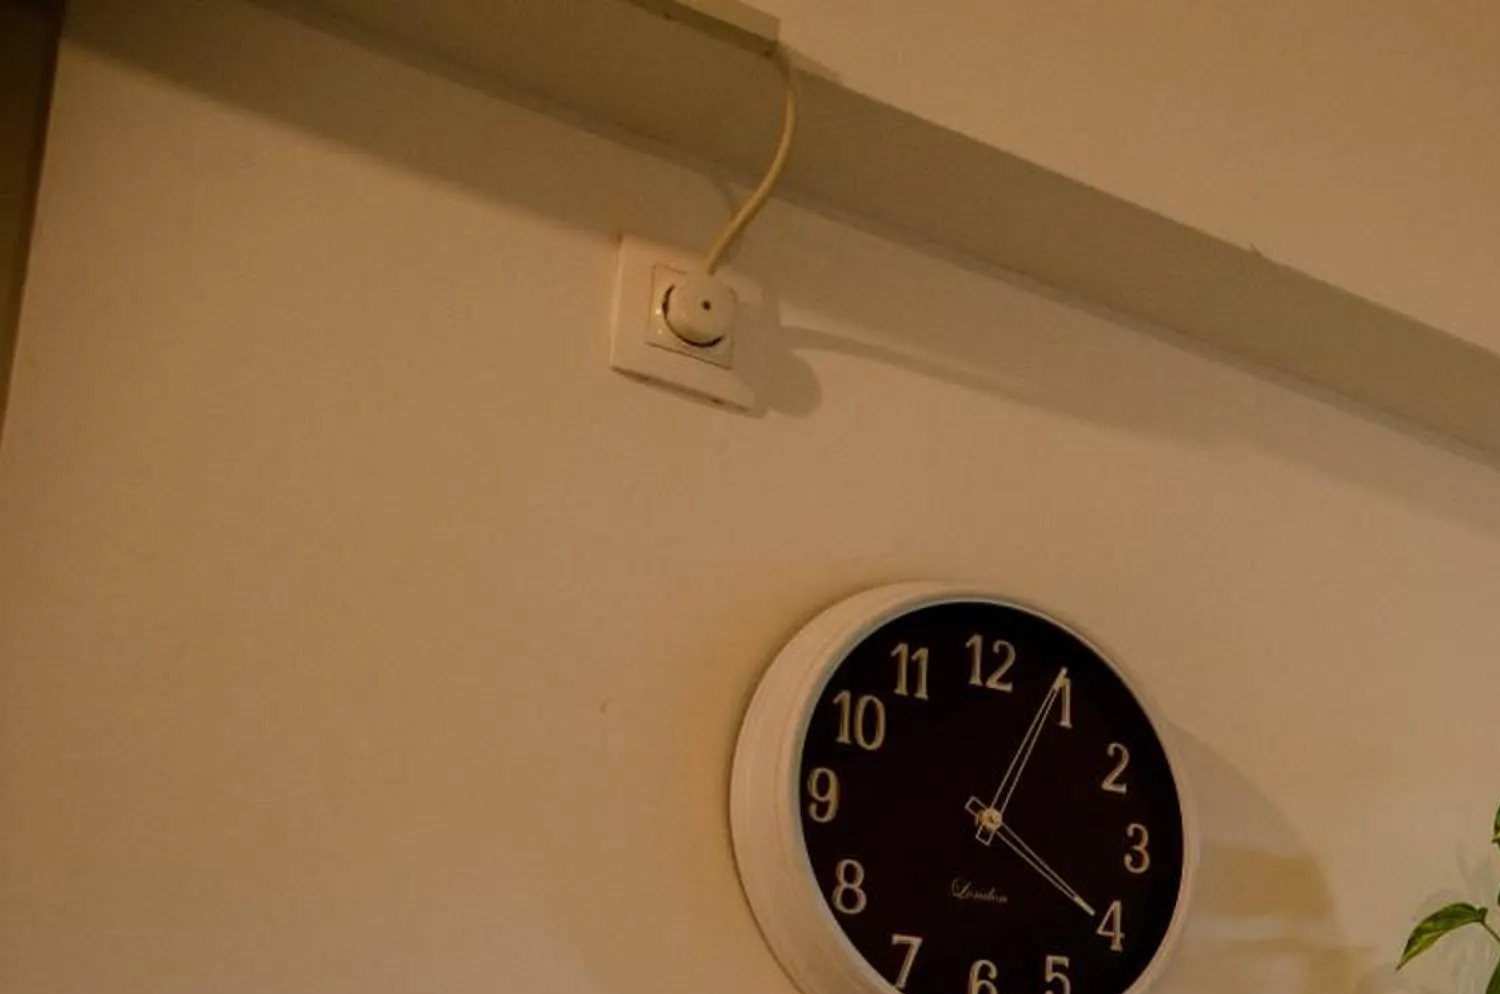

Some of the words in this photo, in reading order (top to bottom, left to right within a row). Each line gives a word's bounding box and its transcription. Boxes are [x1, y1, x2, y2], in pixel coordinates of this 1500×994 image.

[890, 642, 930, 701] 11
[965, 633, 1017, 692] 12
[832, 690, 887, 751] 10
[1057, 672, 1074, 728] 1
[806, 767, 841, 823] 9
[1101, 743, 1131, 794] 2
[1123, 824, 1151, 873] 3
[832, 859, 867, 915] 8
[1095, 901, 1126, 953] 4
[890, 934, 923, 990] 7
